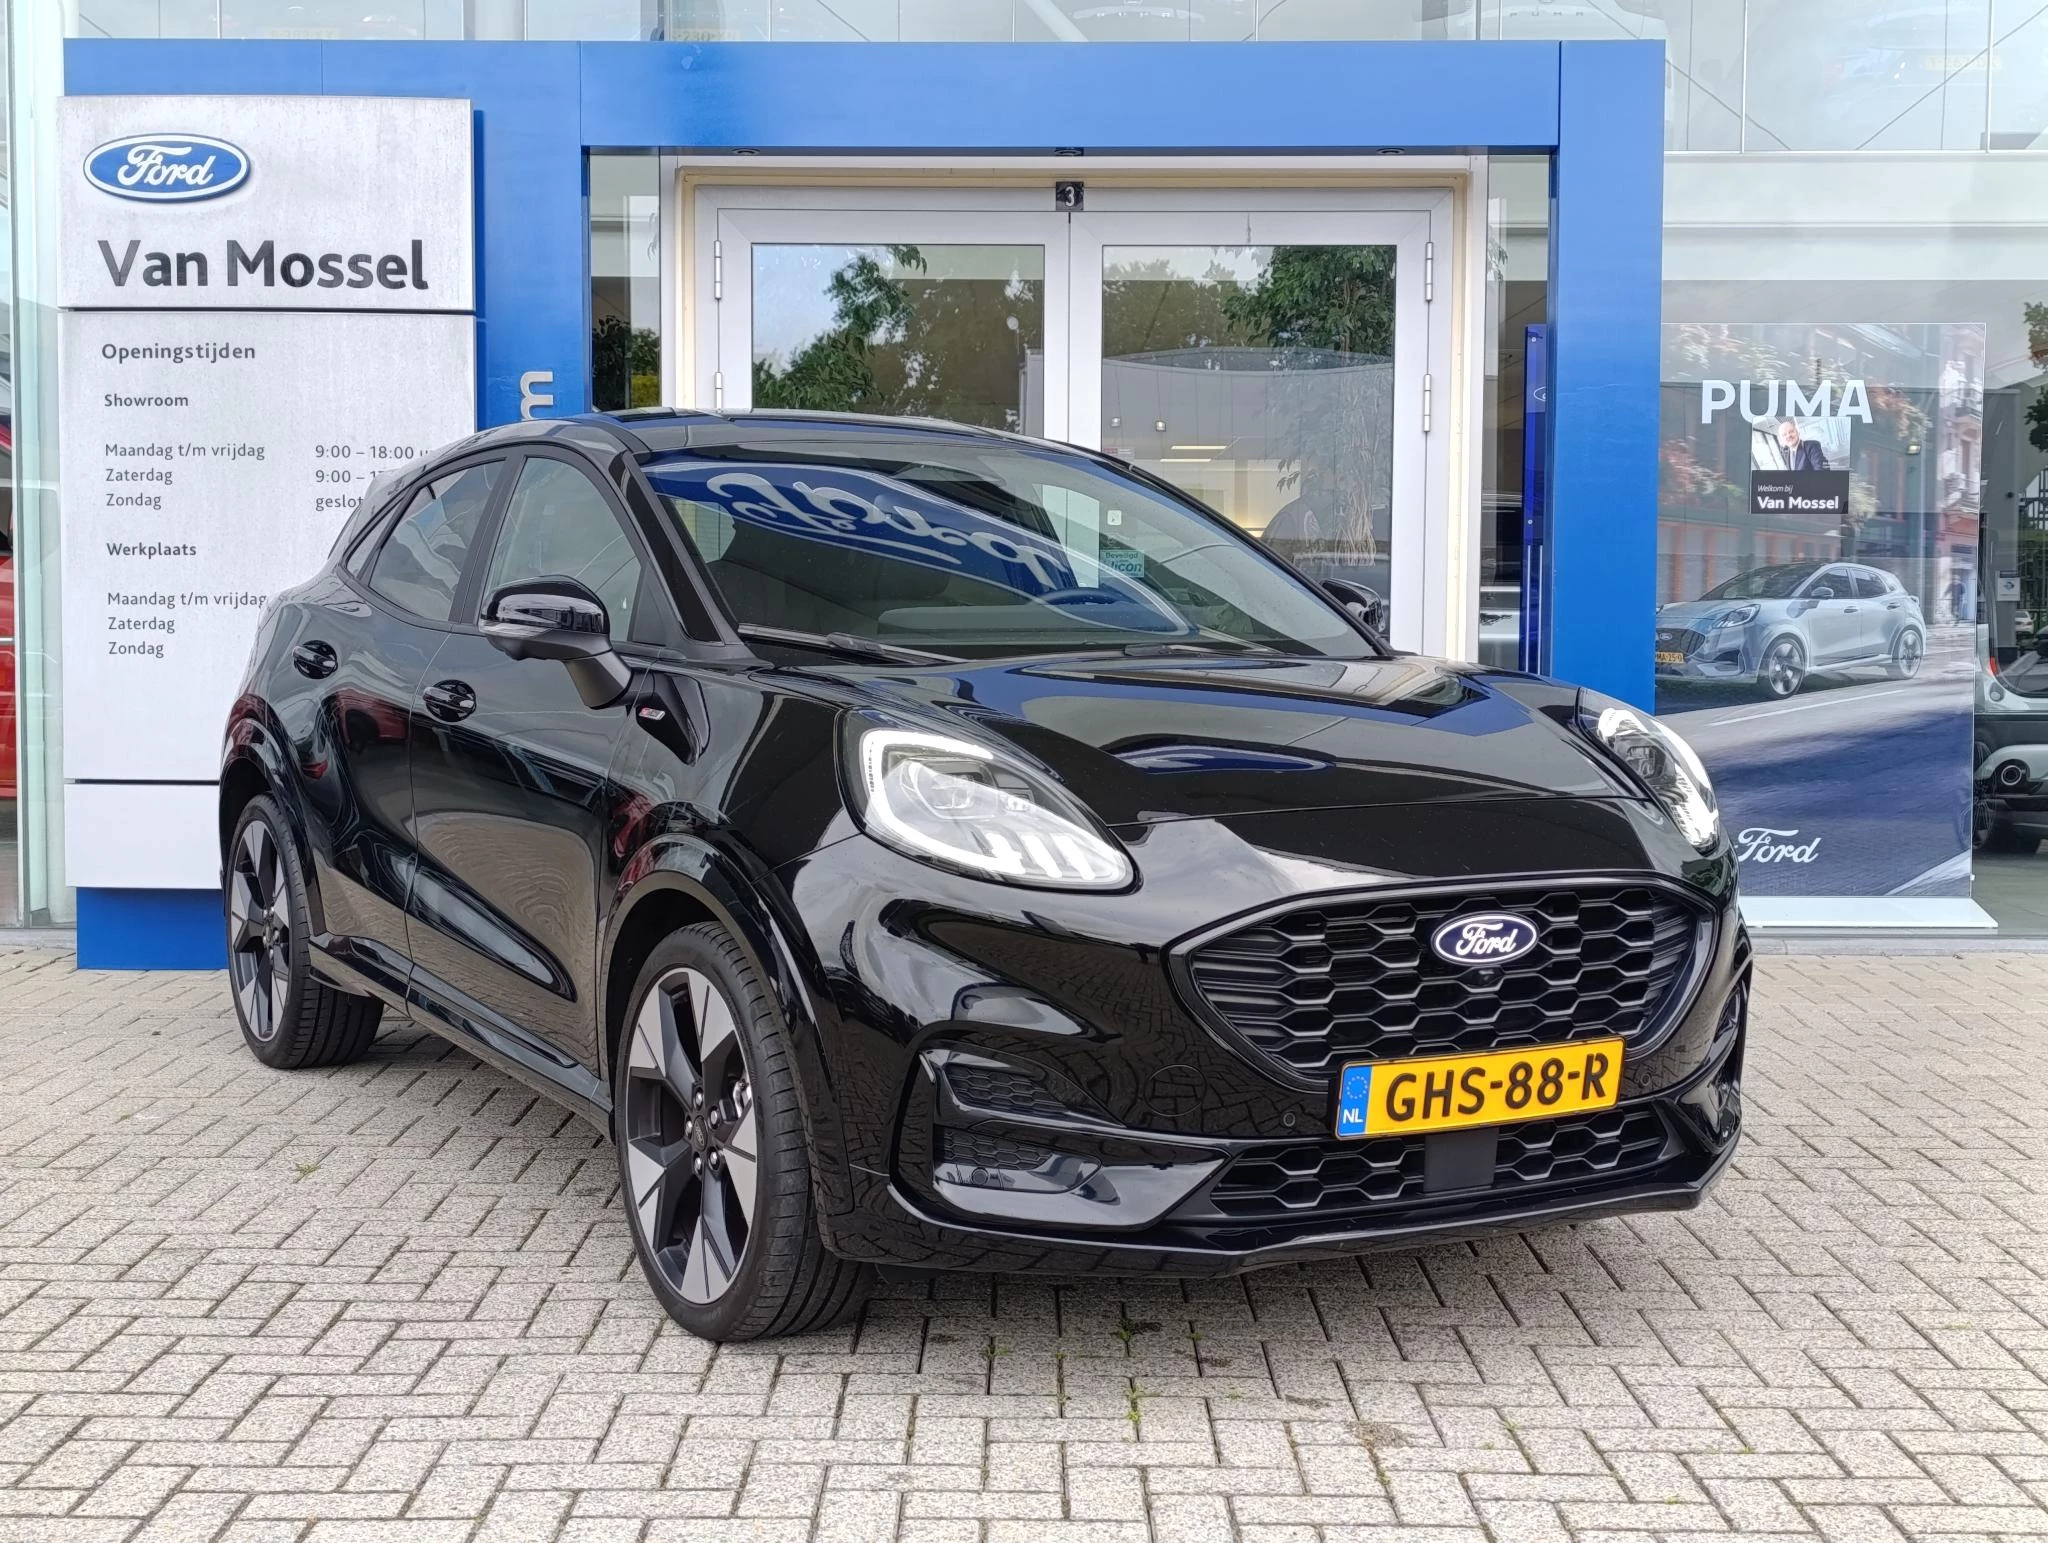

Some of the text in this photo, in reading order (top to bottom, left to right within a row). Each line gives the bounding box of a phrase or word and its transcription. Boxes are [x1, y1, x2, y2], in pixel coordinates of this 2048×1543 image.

[117, 144, 217, 186] Ford
[1065, 186, 1075, 207] 3
[98, 239, 429, 290] Van Mossel
[102, 343, 256, 364] Openingstijden
[104, 393, 189, 407] Showroom
[1702, 379, 1873, 424] PUMA
[105, 442, 174, 461] Maandag
[177, 442, 206, 458] t/m
[211, 442, 265, 461] vrijdag
[315, 444, 351, 458] 9:00
[370, 445, 414, 460] 18:00
[105, 467, 173, 486] Zaterdag
[315, 469, 351, 483] 9:00
[106, 492, 162, 511] Zondag
[1757, 495, 1839, 509] Van Mossel
[106, 541, 197, 560] Werkplaats
[107, 591, 175, 610] Maandag
[180, 591, 208, 606] t/m
[108, 616, 175, 634] Zaterdag
[108, 641, 164, 659] Zondag
[1734, 827, 1822, 863] Ford
[1455, 922, 1517, 956] Ford
[1386, 1053, 1609, 1121] GHS-88-R
[1342, 1107, 1364, 1124] NL
